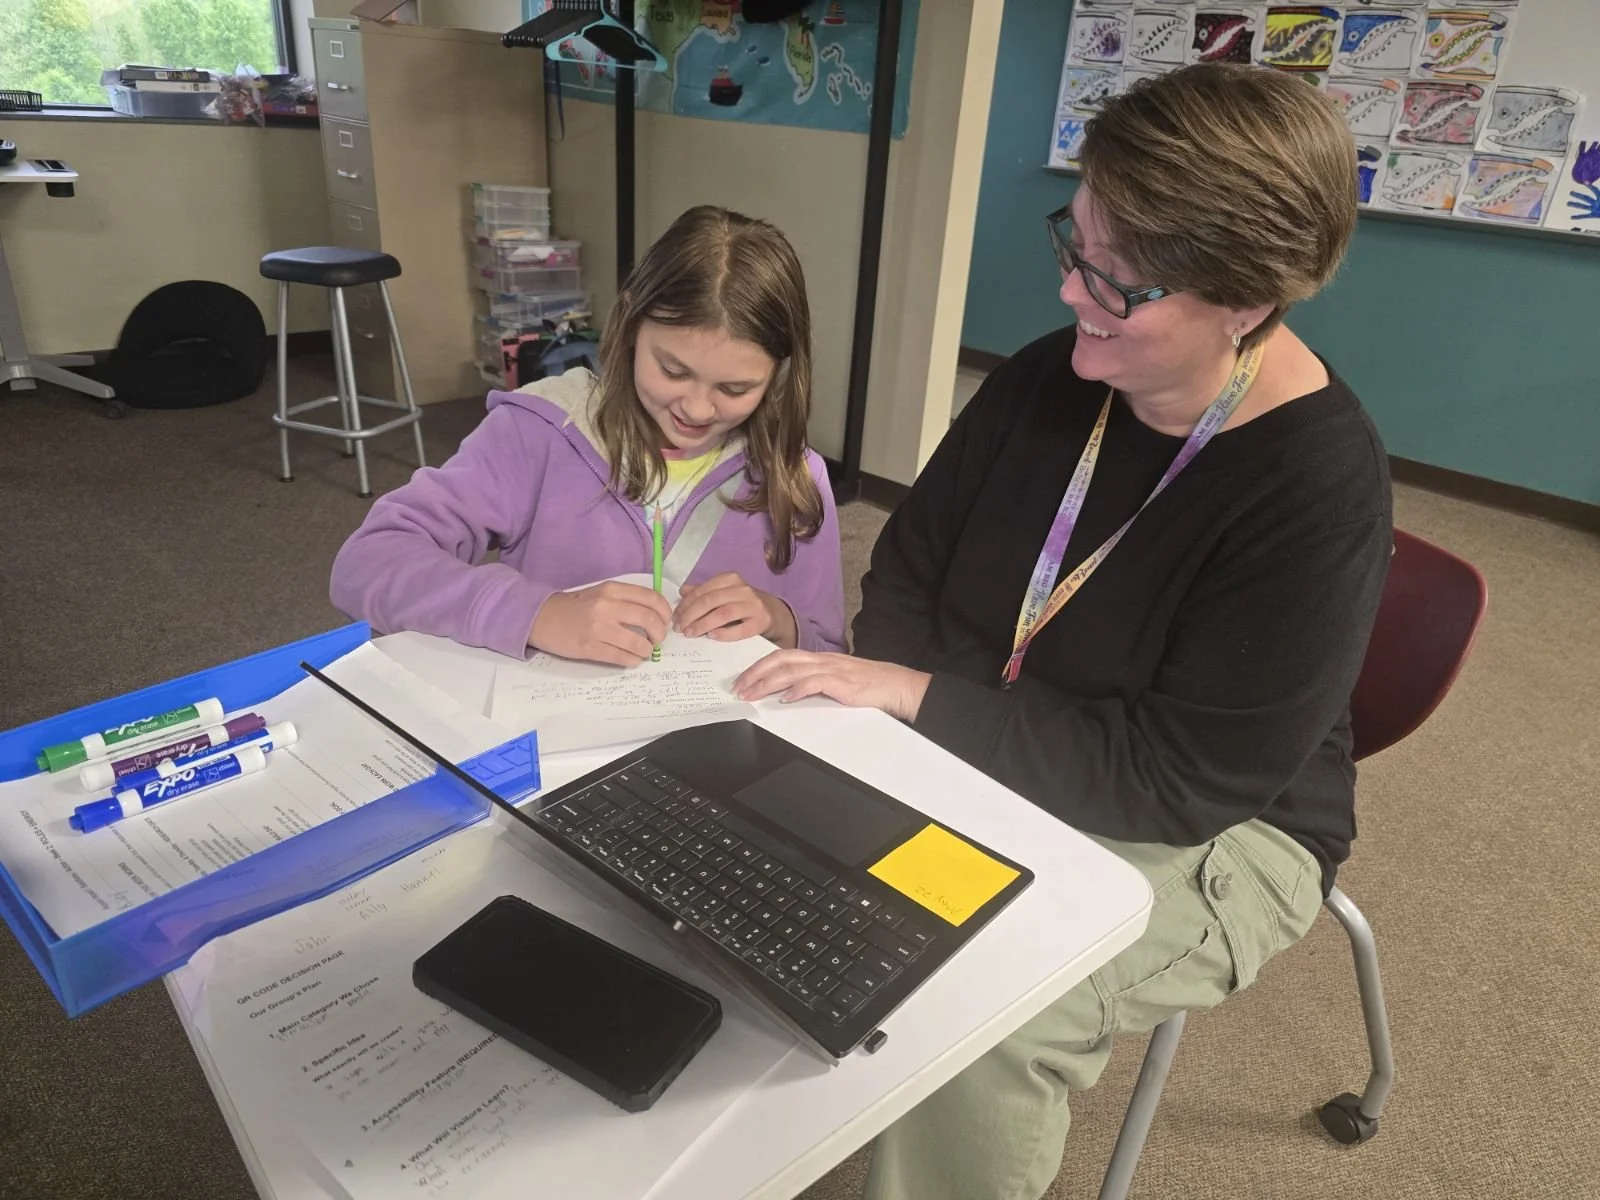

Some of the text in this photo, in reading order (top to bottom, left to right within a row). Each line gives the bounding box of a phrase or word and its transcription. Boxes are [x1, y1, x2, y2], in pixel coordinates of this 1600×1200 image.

[1215, 390, 1238, 415] Have
[1232, 371, 1250, 392] Fun
[1024, 609, 1037, 628] Fun
[155, 747, 174, 759] erase
[174, 742, 190, 755] dry
[218, 760, 236, 773] chisel
[143, 768, 196, 798] EXPO
[166, 781, 200, 798] dry erase
[914, 886, 963, 916] May 22
[236, 950, 345, 1006] QR CODE DECISION PAGE
[249, 980, 323, 1020] Our Group's Plan
[278, 1020, 300, 1035] Main
[300, 996, 339, 1024] Category
[339, 991, 353, 1004] We
[353, 976, 380, 993] Chose
[312, 1045, 347, 1068] Specific
[371, 1086, 427, 1127] Accessibility
[424, 1064, 457, 1089] Feature
[408, 1145, 434, 1164] What
[434, 1125, 451, 1146] Will
[450, 1104, 483, 1132] Visitors
[482, 1083, 511, 1109] Learn?
